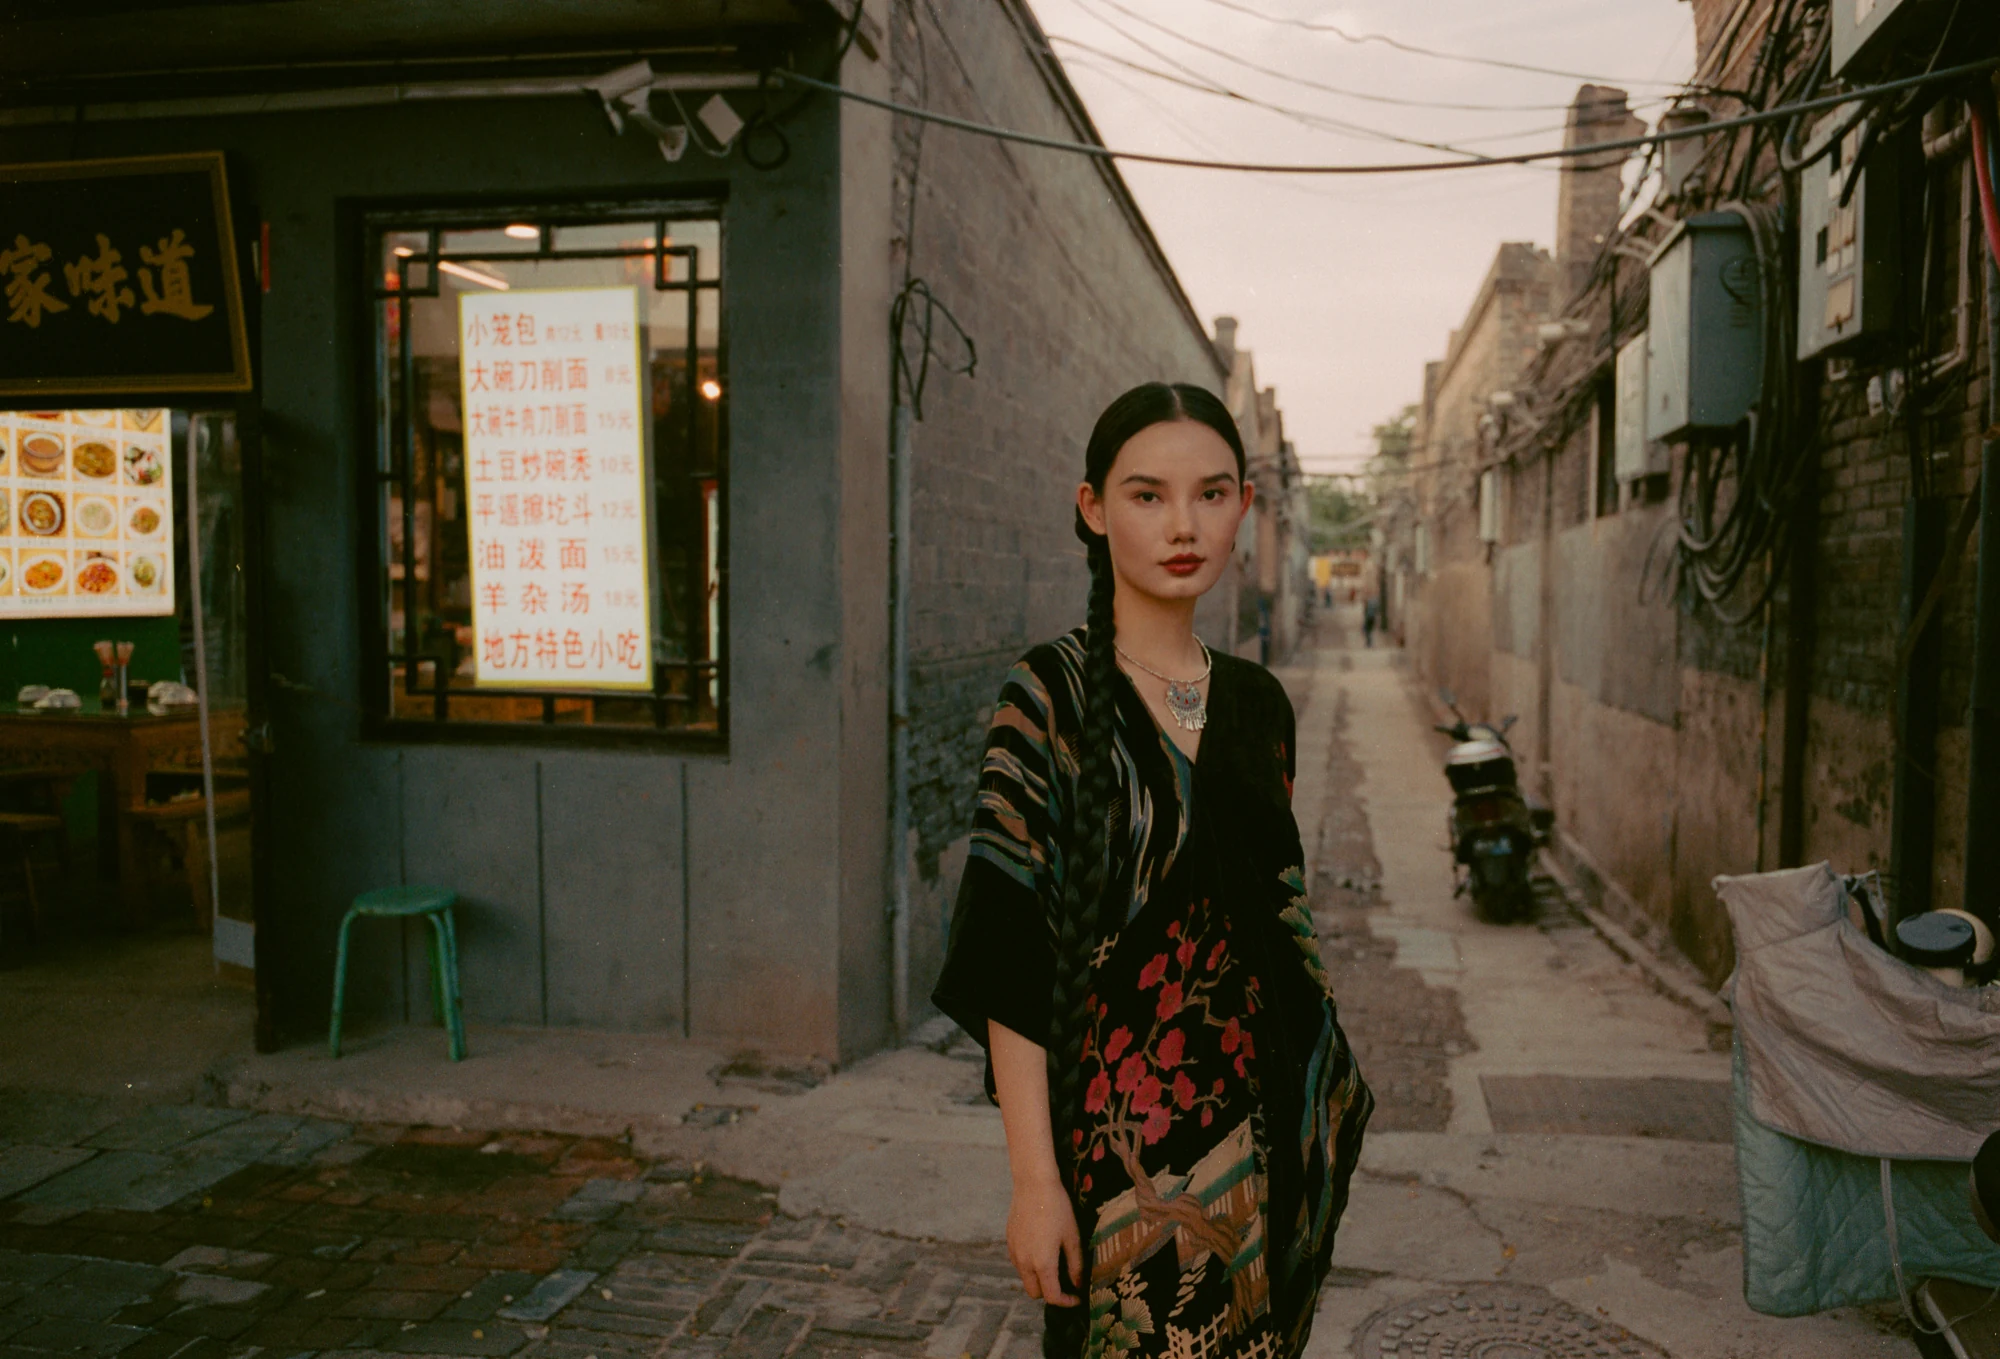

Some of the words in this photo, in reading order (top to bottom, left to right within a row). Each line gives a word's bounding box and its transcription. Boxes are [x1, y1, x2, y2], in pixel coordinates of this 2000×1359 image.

[0, 229, 215, 328] 家味道
[467, 313, 537, 347] 小笼包
[469, 357, 589, 392] 大碗刀削面
[471, 403, 588, 437] 大碗牛肉刀削面
[598, 410, 634, 431] 15元
[475, 448, 592, 482] 土豆炒碗秃
[600, 454, 635, 474] 10元
[602, 499, 638, 519] 12元
[478, 538, 587, 571] 油泼面
[603, 544, 640, 564] 15元
[481, 582, 590, 615] 羊杂汤
[483, 627, 642, 670] 地方特色小吃
